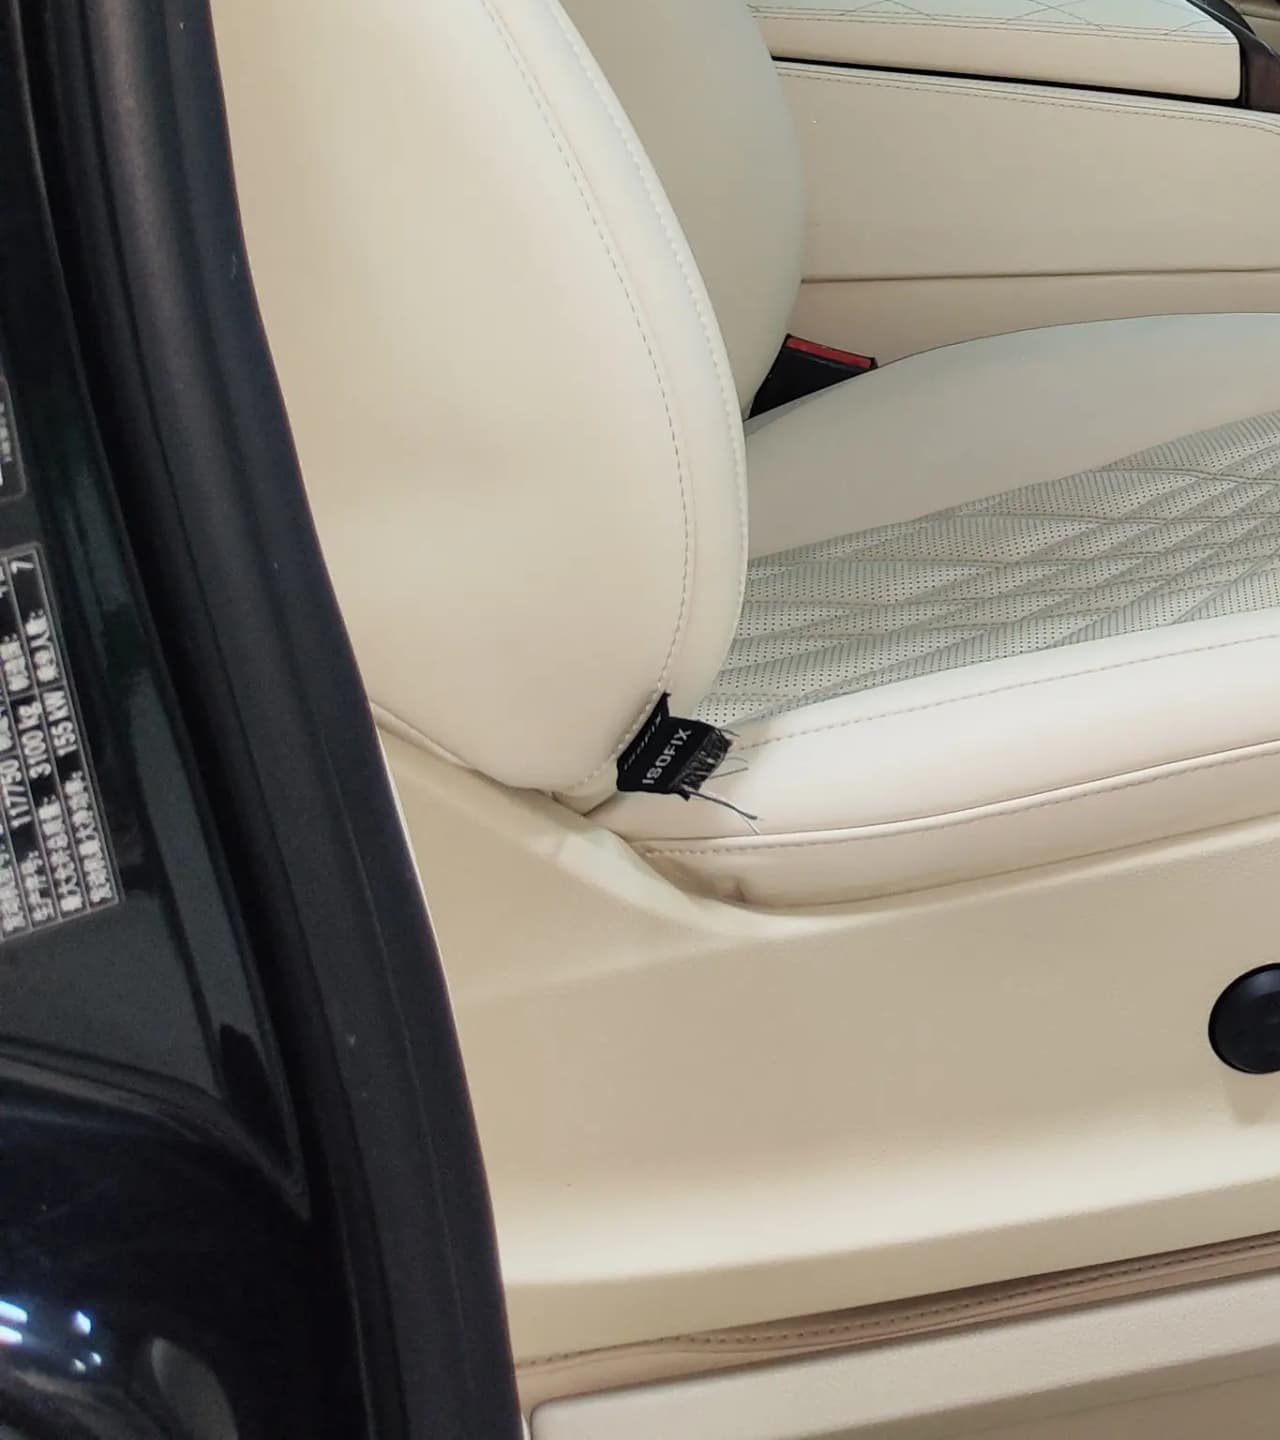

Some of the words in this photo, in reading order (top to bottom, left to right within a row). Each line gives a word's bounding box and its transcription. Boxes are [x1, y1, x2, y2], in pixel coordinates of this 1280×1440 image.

[17, 700, 44, 731] kg
[21, 729, 52, 779] 3100
[51, 720, 78, 757] 155
[642, 728, 692, 785] ISOFIX
